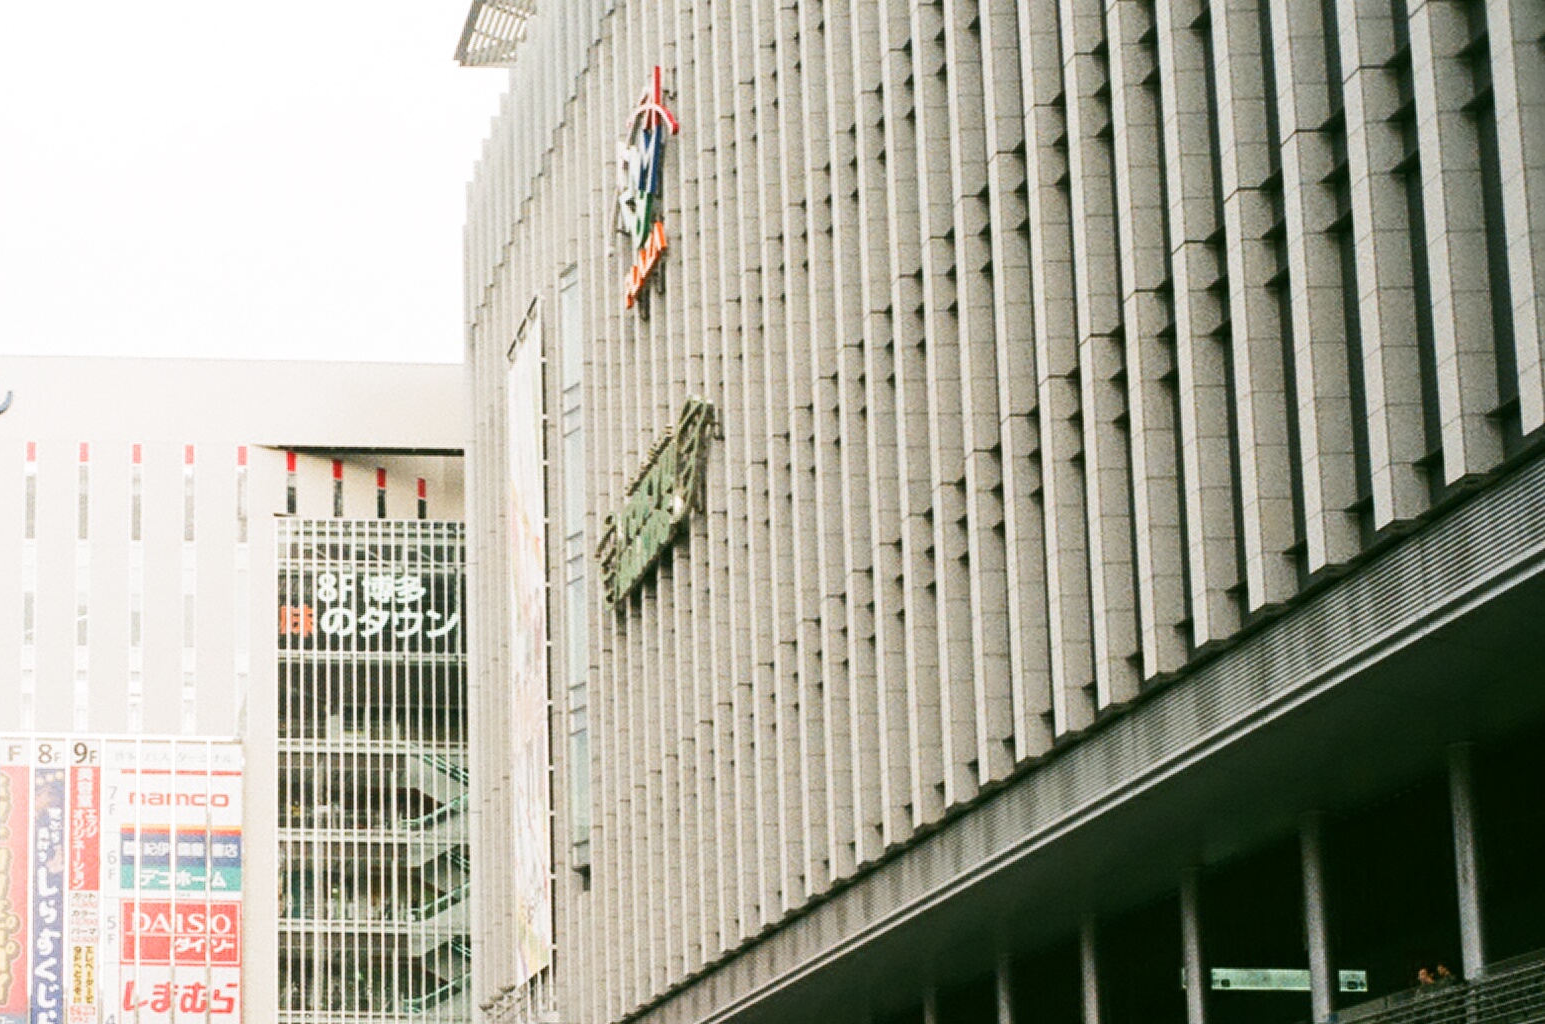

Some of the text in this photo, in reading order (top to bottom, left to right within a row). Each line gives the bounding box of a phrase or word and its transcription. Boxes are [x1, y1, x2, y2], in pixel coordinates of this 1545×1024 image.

[38, 744, 61, 764] 8F
[74, 742, 97, 764] 9F
[129, 792, 230, 808] namco
[131, 911, 232, 935] DAISO
[175, 937, 234, 953] ダイソー
[123, 980, 239, 1015] しまむら
